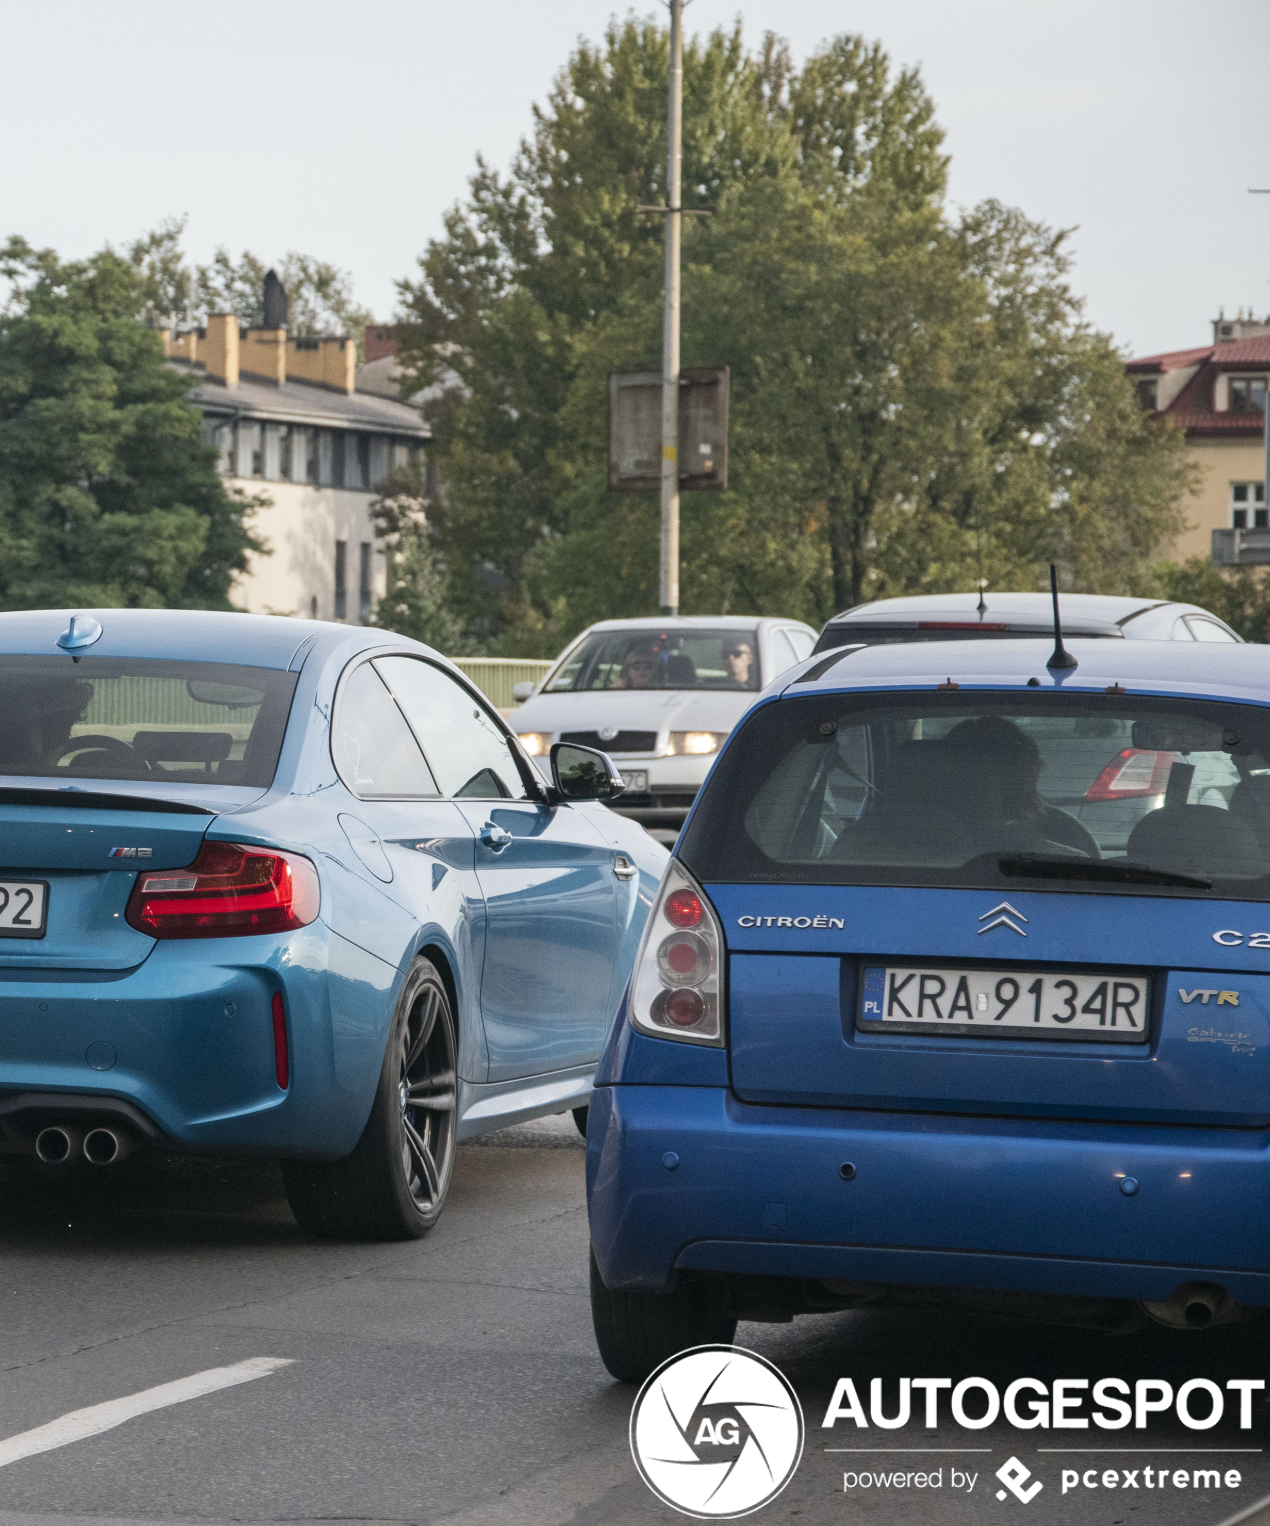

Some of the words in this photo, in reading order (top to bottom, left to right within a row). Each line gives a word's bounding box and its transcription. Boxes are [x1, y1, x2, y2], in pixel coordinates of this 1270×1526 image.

[119, 847, 153, 858] M2
[738, 914, 845, 929] CITROËN
[1212, 929, 1270, 949] C2
[887, 973, 974, 1020] KRA
[994, 977, 1141, 1028] 9134R
[1178, 988, 1240, 1006] VTR
[864, 1001, 881, 1013] PL
